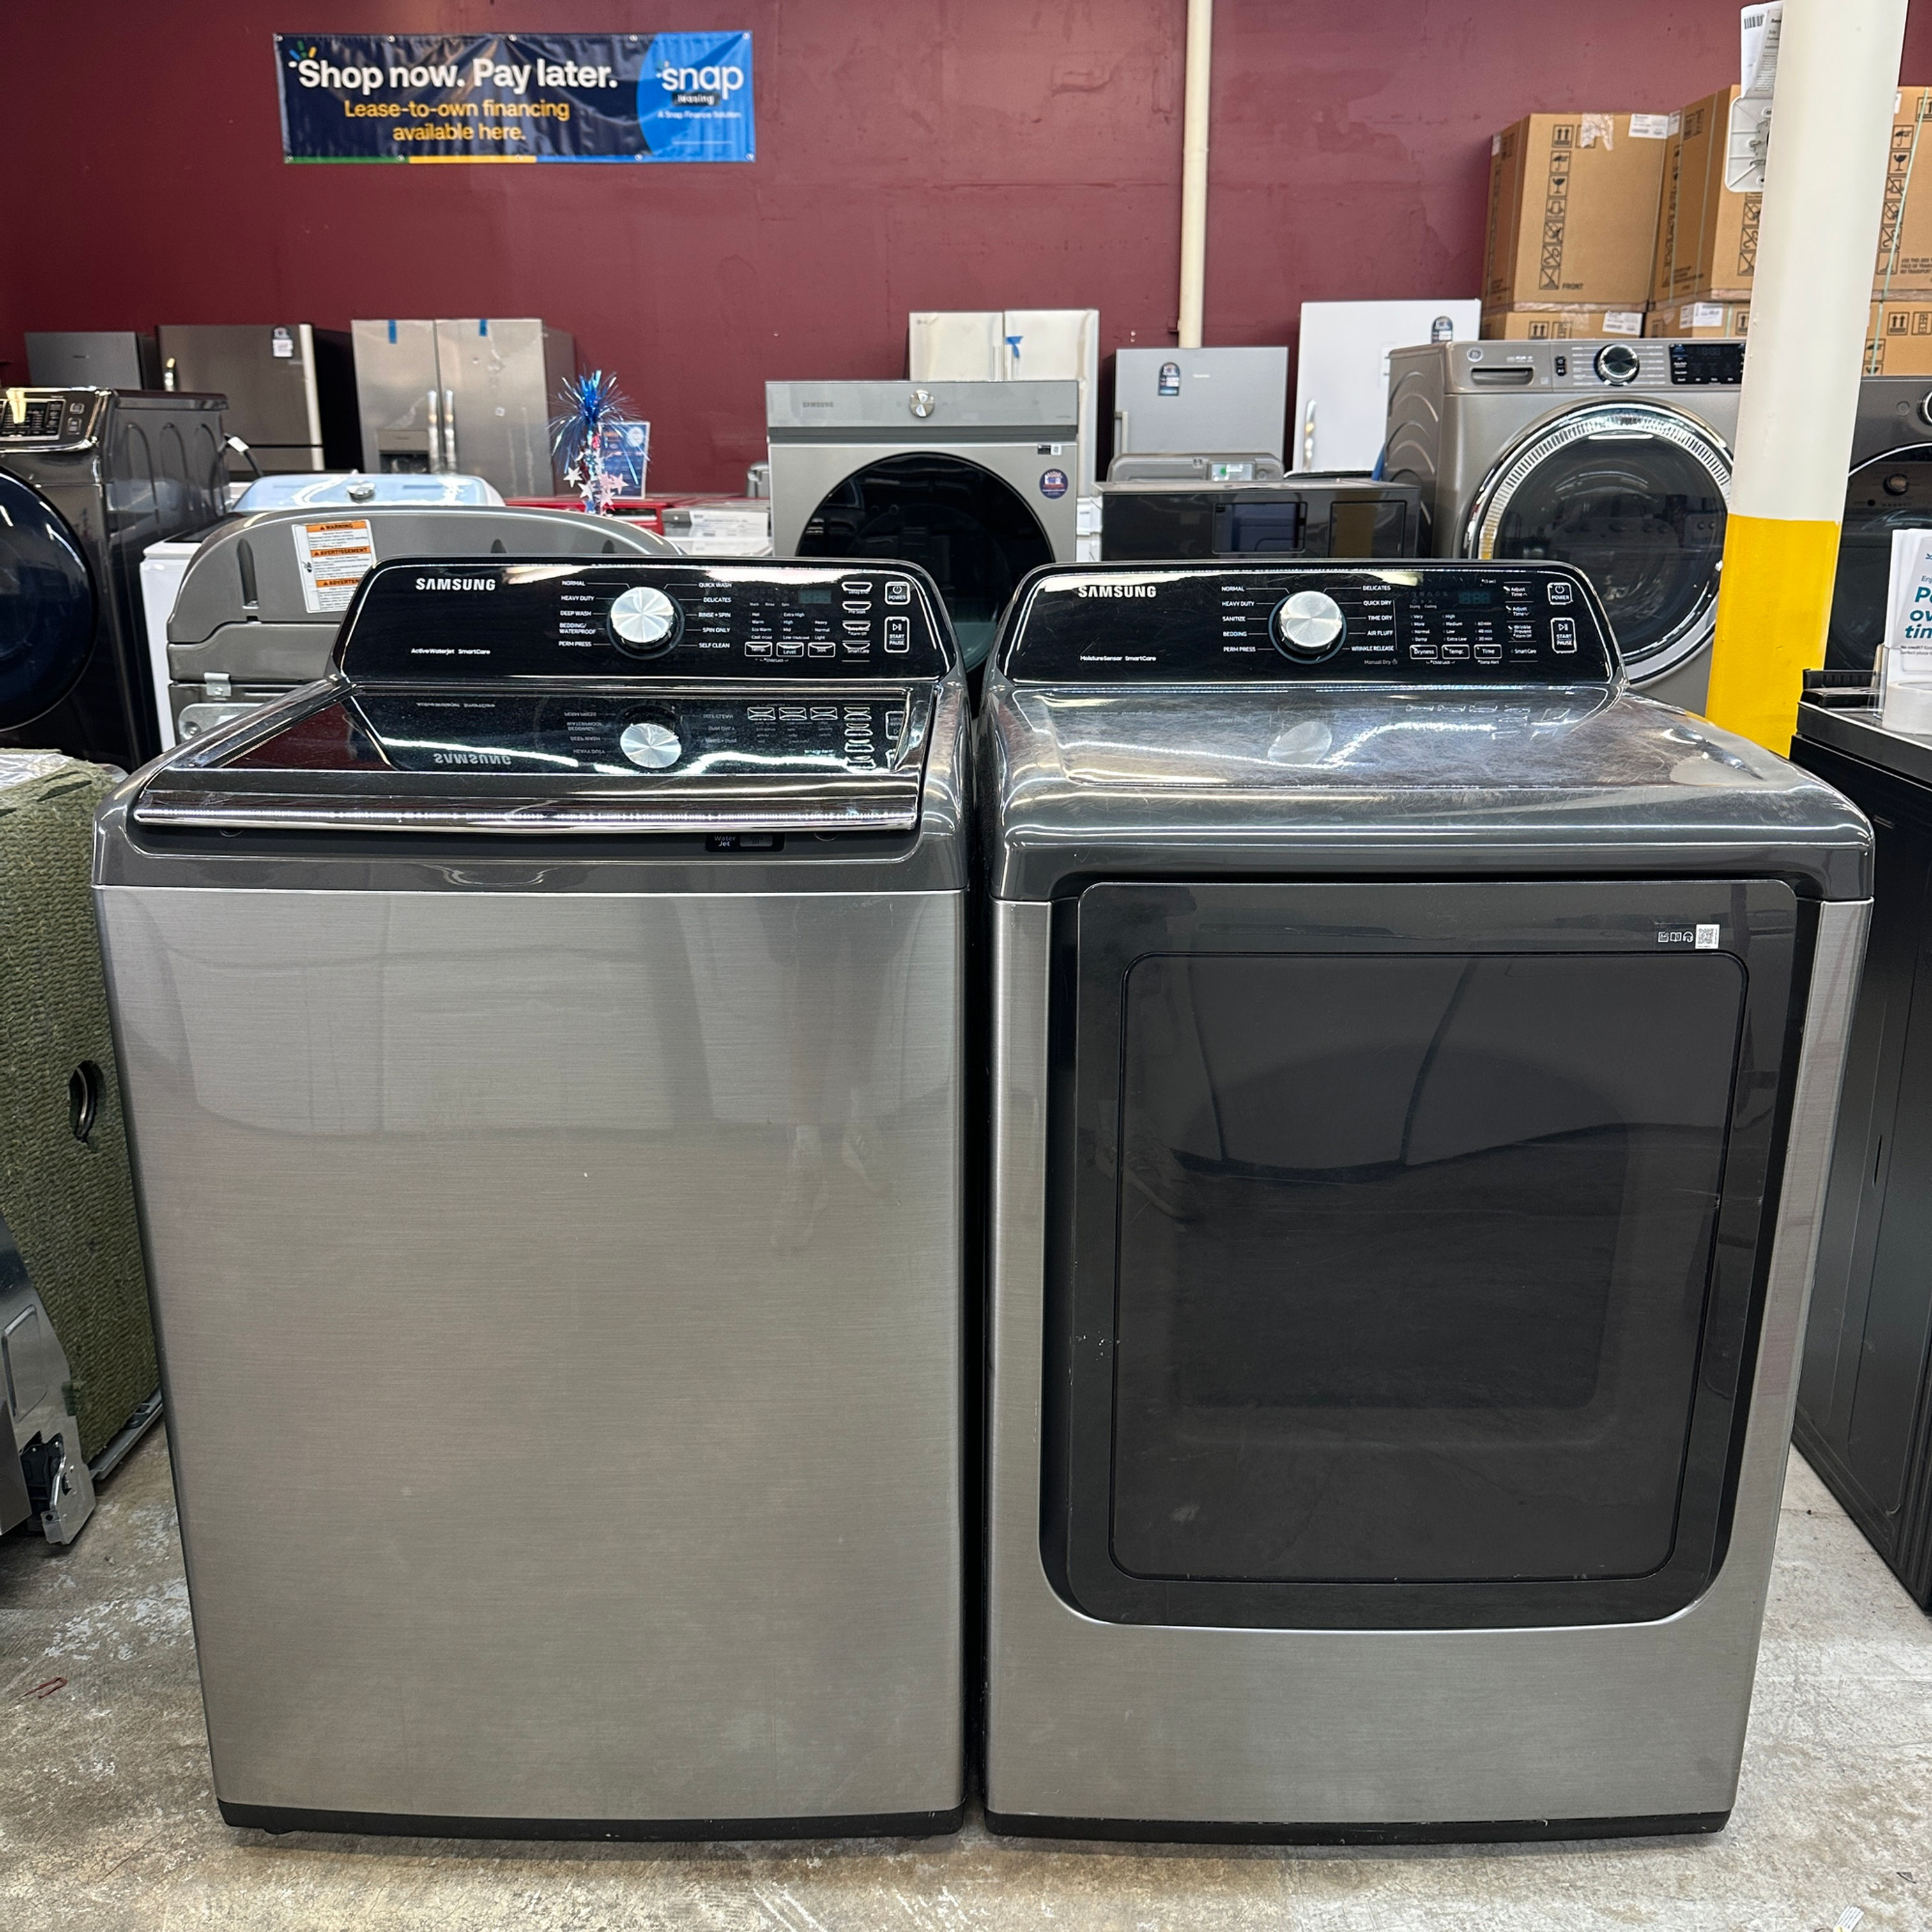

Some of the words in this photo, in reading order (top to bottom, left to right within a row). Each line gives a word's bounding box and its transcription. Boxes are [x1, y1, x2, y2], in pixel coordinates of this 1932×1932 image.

[298, 59, 384, 95] Shop
[389, 65, 465, 88] now.
[473, 57, 531, 94] Pay
[537, 57, 618, 88] later.
[661, 66, 744, 100] snap
[677, 93, 715, 105] leasing
[344, 100, 478, 117] Lease-to-own
[482, 98, 570, 121] financing
[392, 122, 474, 140] available
[479, 123, 526, 140] here.
[416, 578, 496, 590] SAMSUNG
[1921, 575, 1932, 584] Enj
[1078, 585, 1156, 597] SAMSUNG
